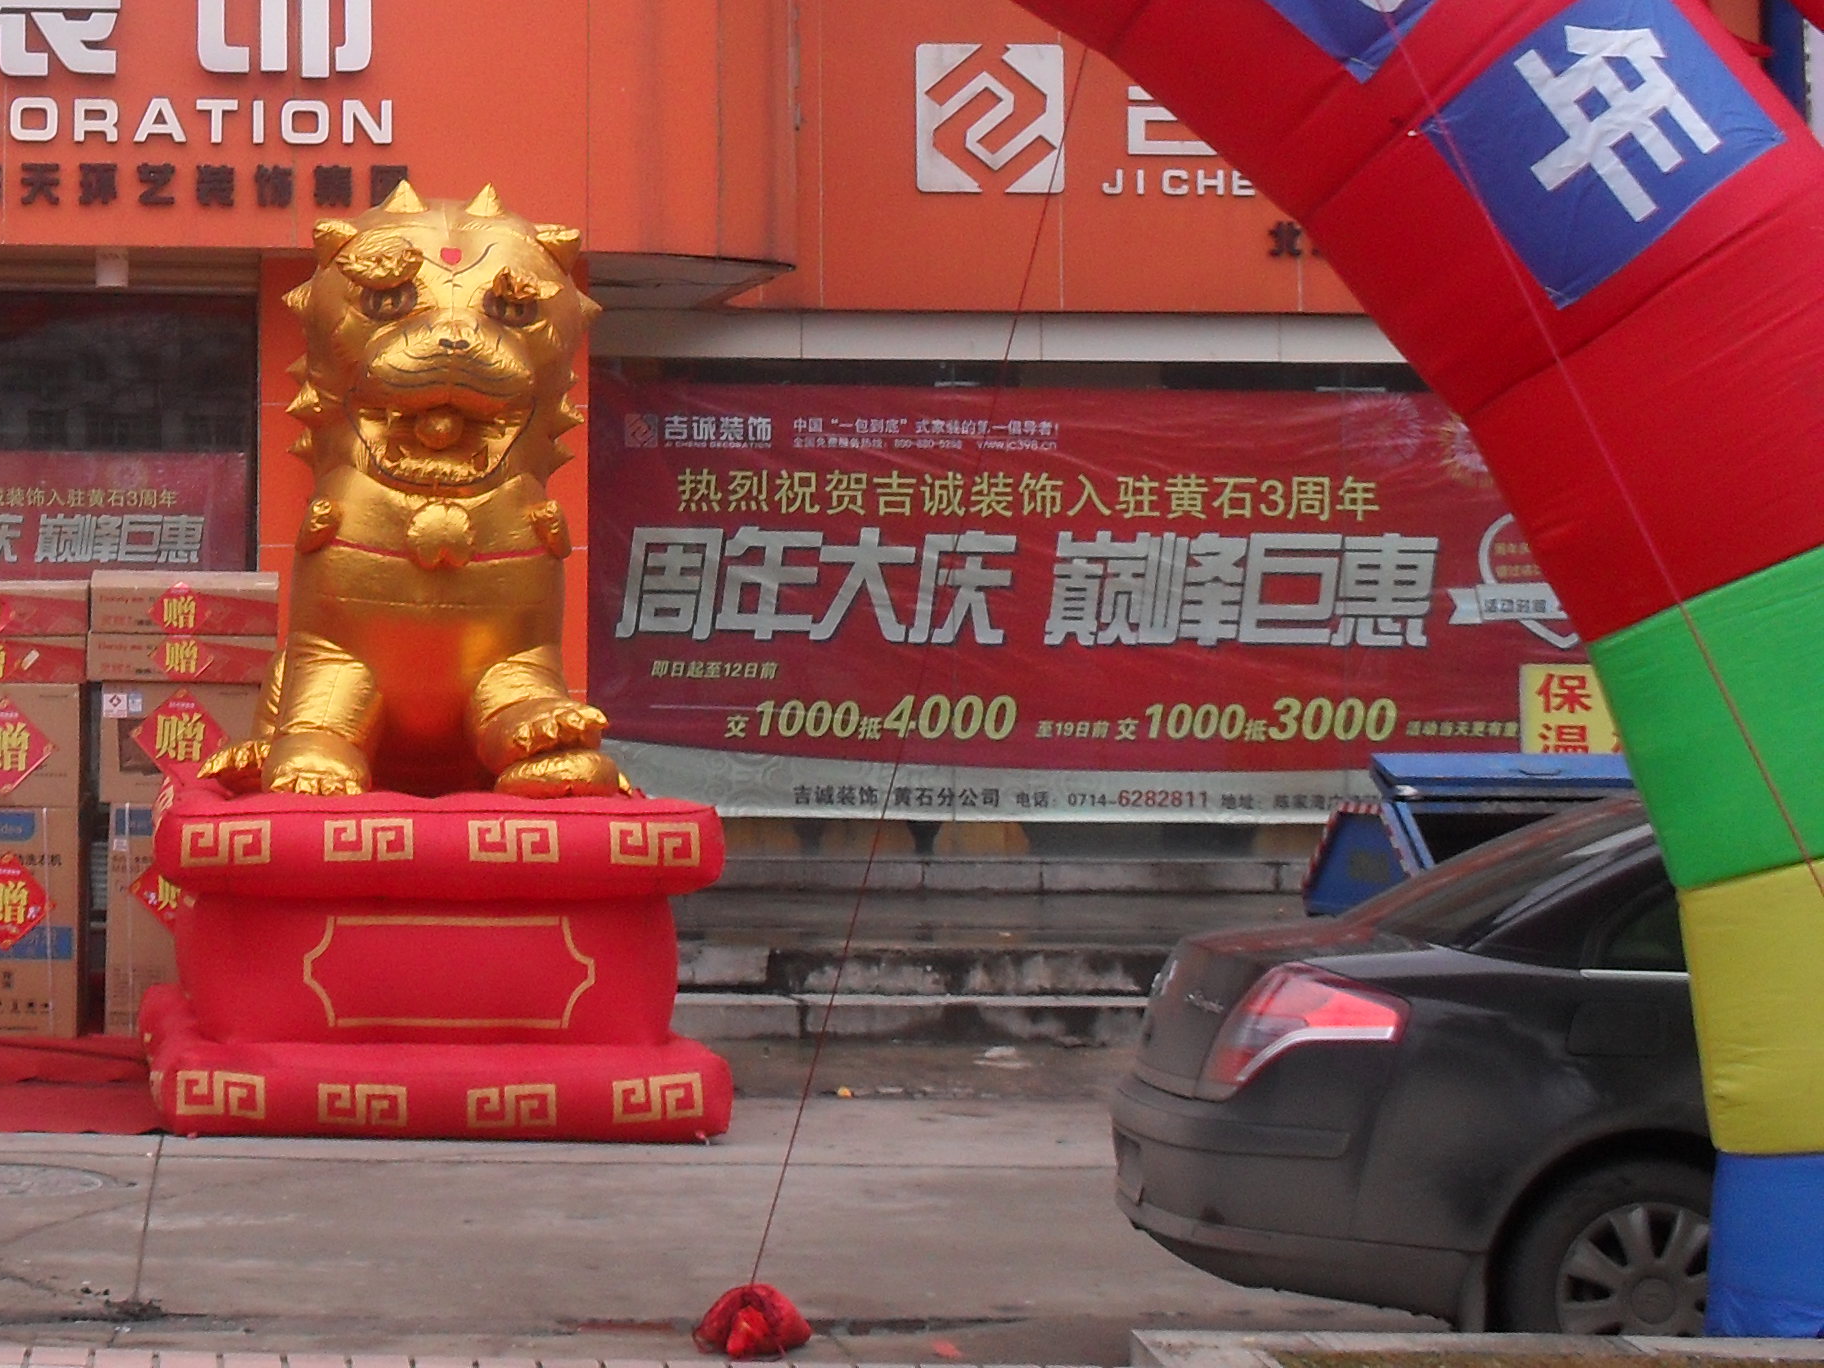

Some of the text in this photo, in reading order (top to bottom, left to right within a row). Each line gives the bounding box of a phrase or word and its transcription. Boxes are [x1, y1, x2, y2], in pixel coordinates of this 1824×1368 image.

[664, 415, 772, 441] 吉诚装饰
[677, 468, 1381, 521] 热烈祝贺吉诚装饰入驻黄石3周年
[34, 513, 205, 564] 巅峰巨惠
[615, 526, 1440, 648] 周年大庆 巅峰巨惠
[162, 595, 197, 629] 赠
[165, 640, 199, 674] 赠
[651, 660, 779, 680] 即日起至12日前
[155, 712, 206, 762] 赠
[793, 785, 878, 807] 吉诚装饰
[893, 786, 1000, 809] 黄石分公司
